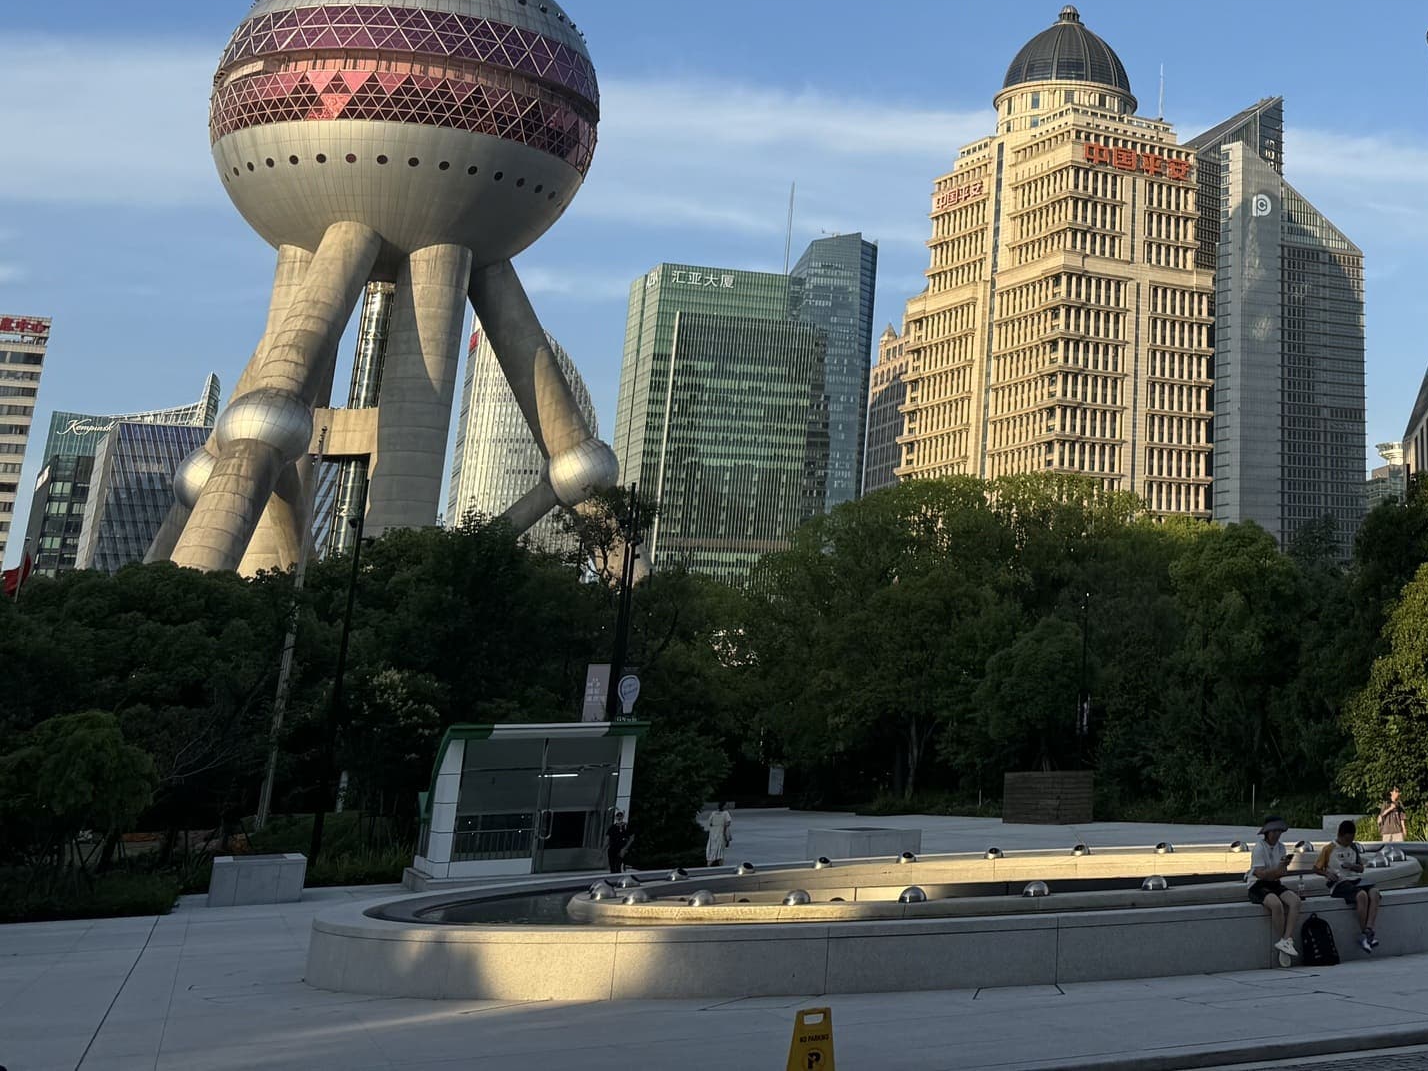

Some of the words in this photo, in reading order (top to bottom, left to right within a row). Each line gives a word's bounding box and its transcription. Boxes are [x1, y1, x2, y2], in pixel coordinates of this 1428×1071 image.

[1084, 142, 1190, 181] 中国平安
[936, 181, 983, 209] 中国平安
[671, 270, 735, 289] 汇亚大厦
[57, 418, 116, 435] Kempinsk
